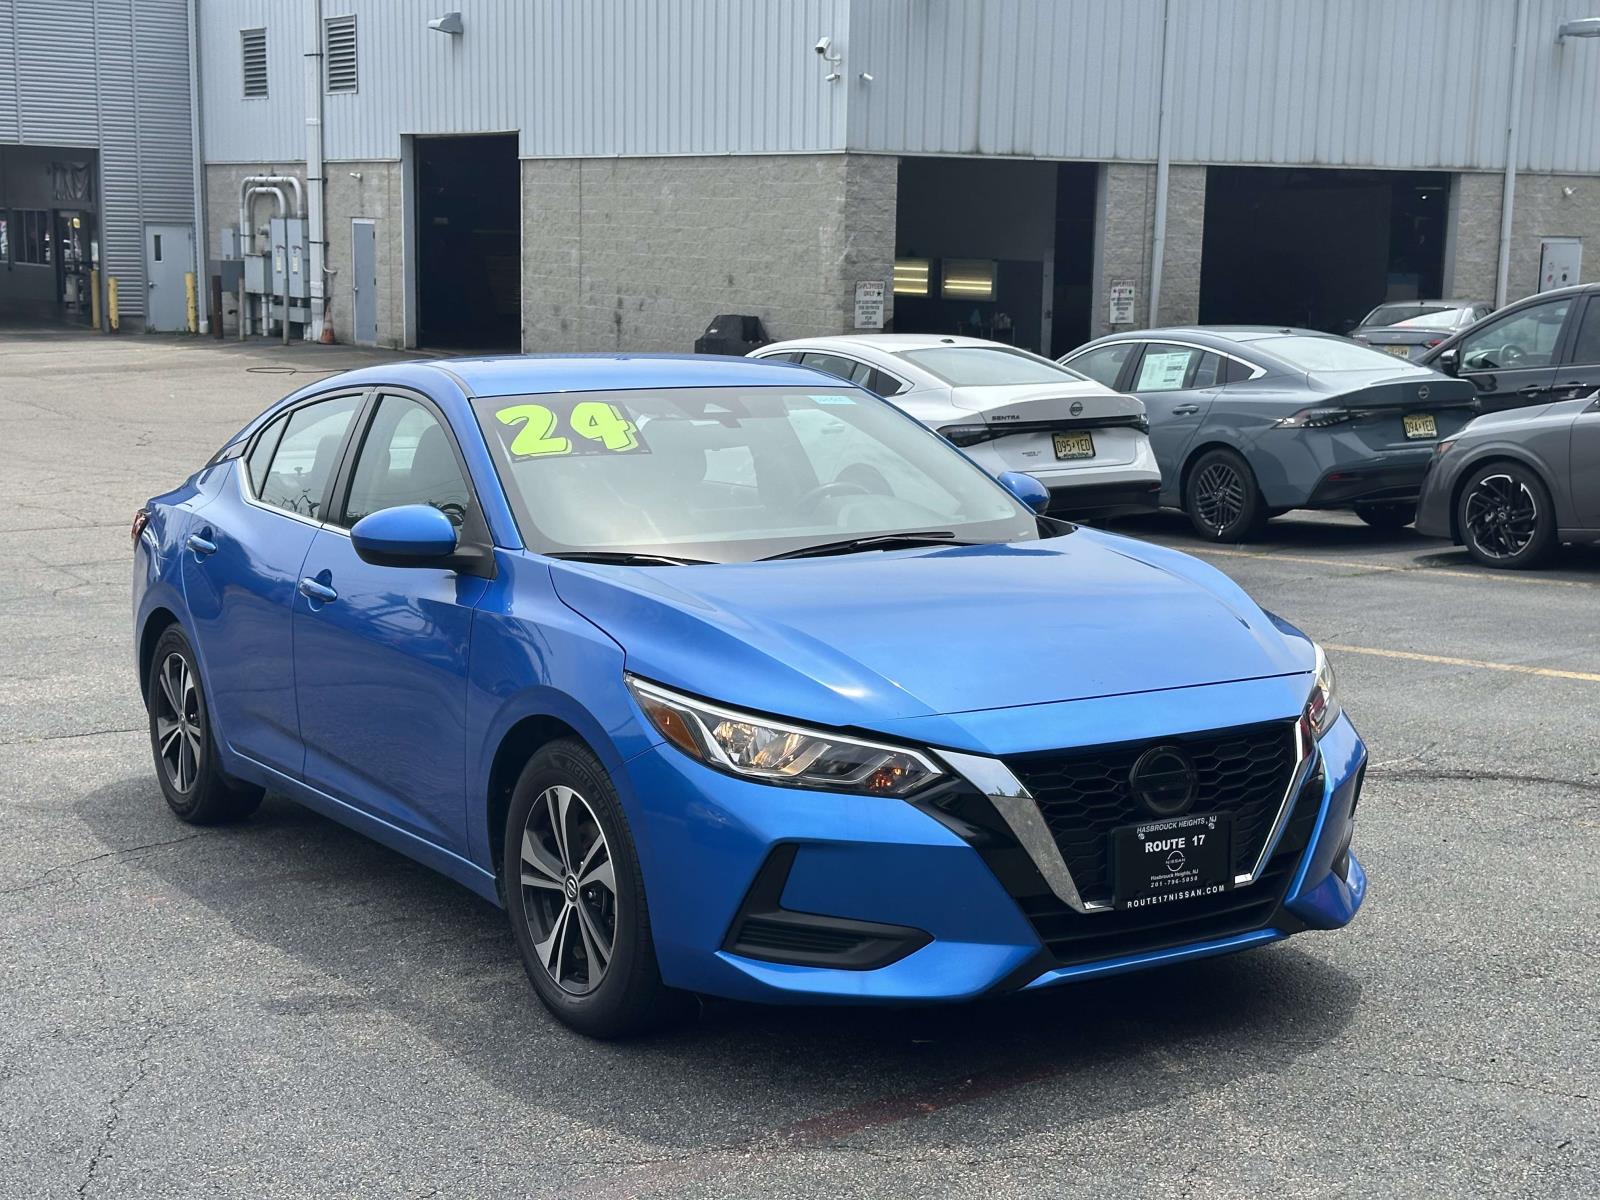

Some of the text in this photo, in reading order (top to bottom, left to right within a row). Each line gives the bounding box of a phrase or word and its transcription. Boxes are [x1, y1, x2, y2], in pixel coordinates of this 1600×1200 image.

[495, 401, 639, 456] 24
[1137, 822, 1178, 834] HASBROUCK
[1209, 815, 1217, 823] NJ
[1145, 834, 1206, 853] ROUTE 17
[1165, 857, 1186, 865] NISSAN
[1127, 884, 1225, 909] ROUTE17NISSAN.COM
